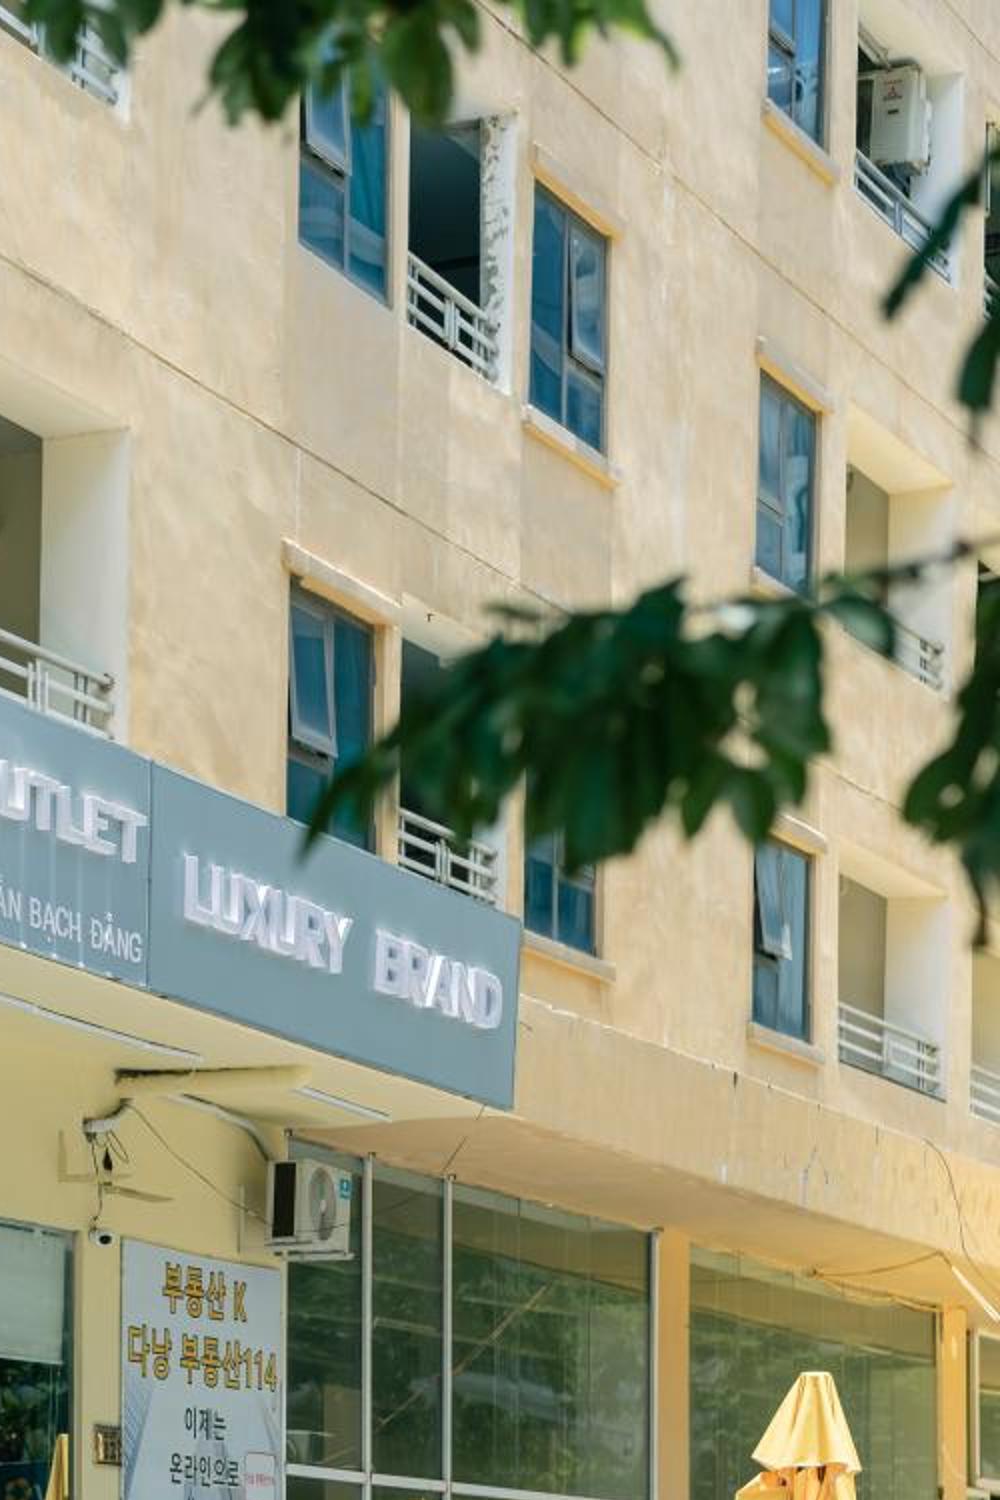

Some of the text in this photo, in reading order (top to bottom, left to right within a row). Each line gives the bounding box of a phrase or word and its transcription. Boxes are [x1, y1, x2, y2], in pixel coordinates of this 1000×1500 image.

[29, 897, 82, 943] BẠCH
[182, 853, 502, 1029] LUXURY BRAND
[162, 1262, 248, 1322] 부동산 K
[127, 1324, 278, 1392] 다낭 부동산114
[184, 1407, 227, 1441] 이제는
[169, 1452, 240, 1488] 온라인으로
